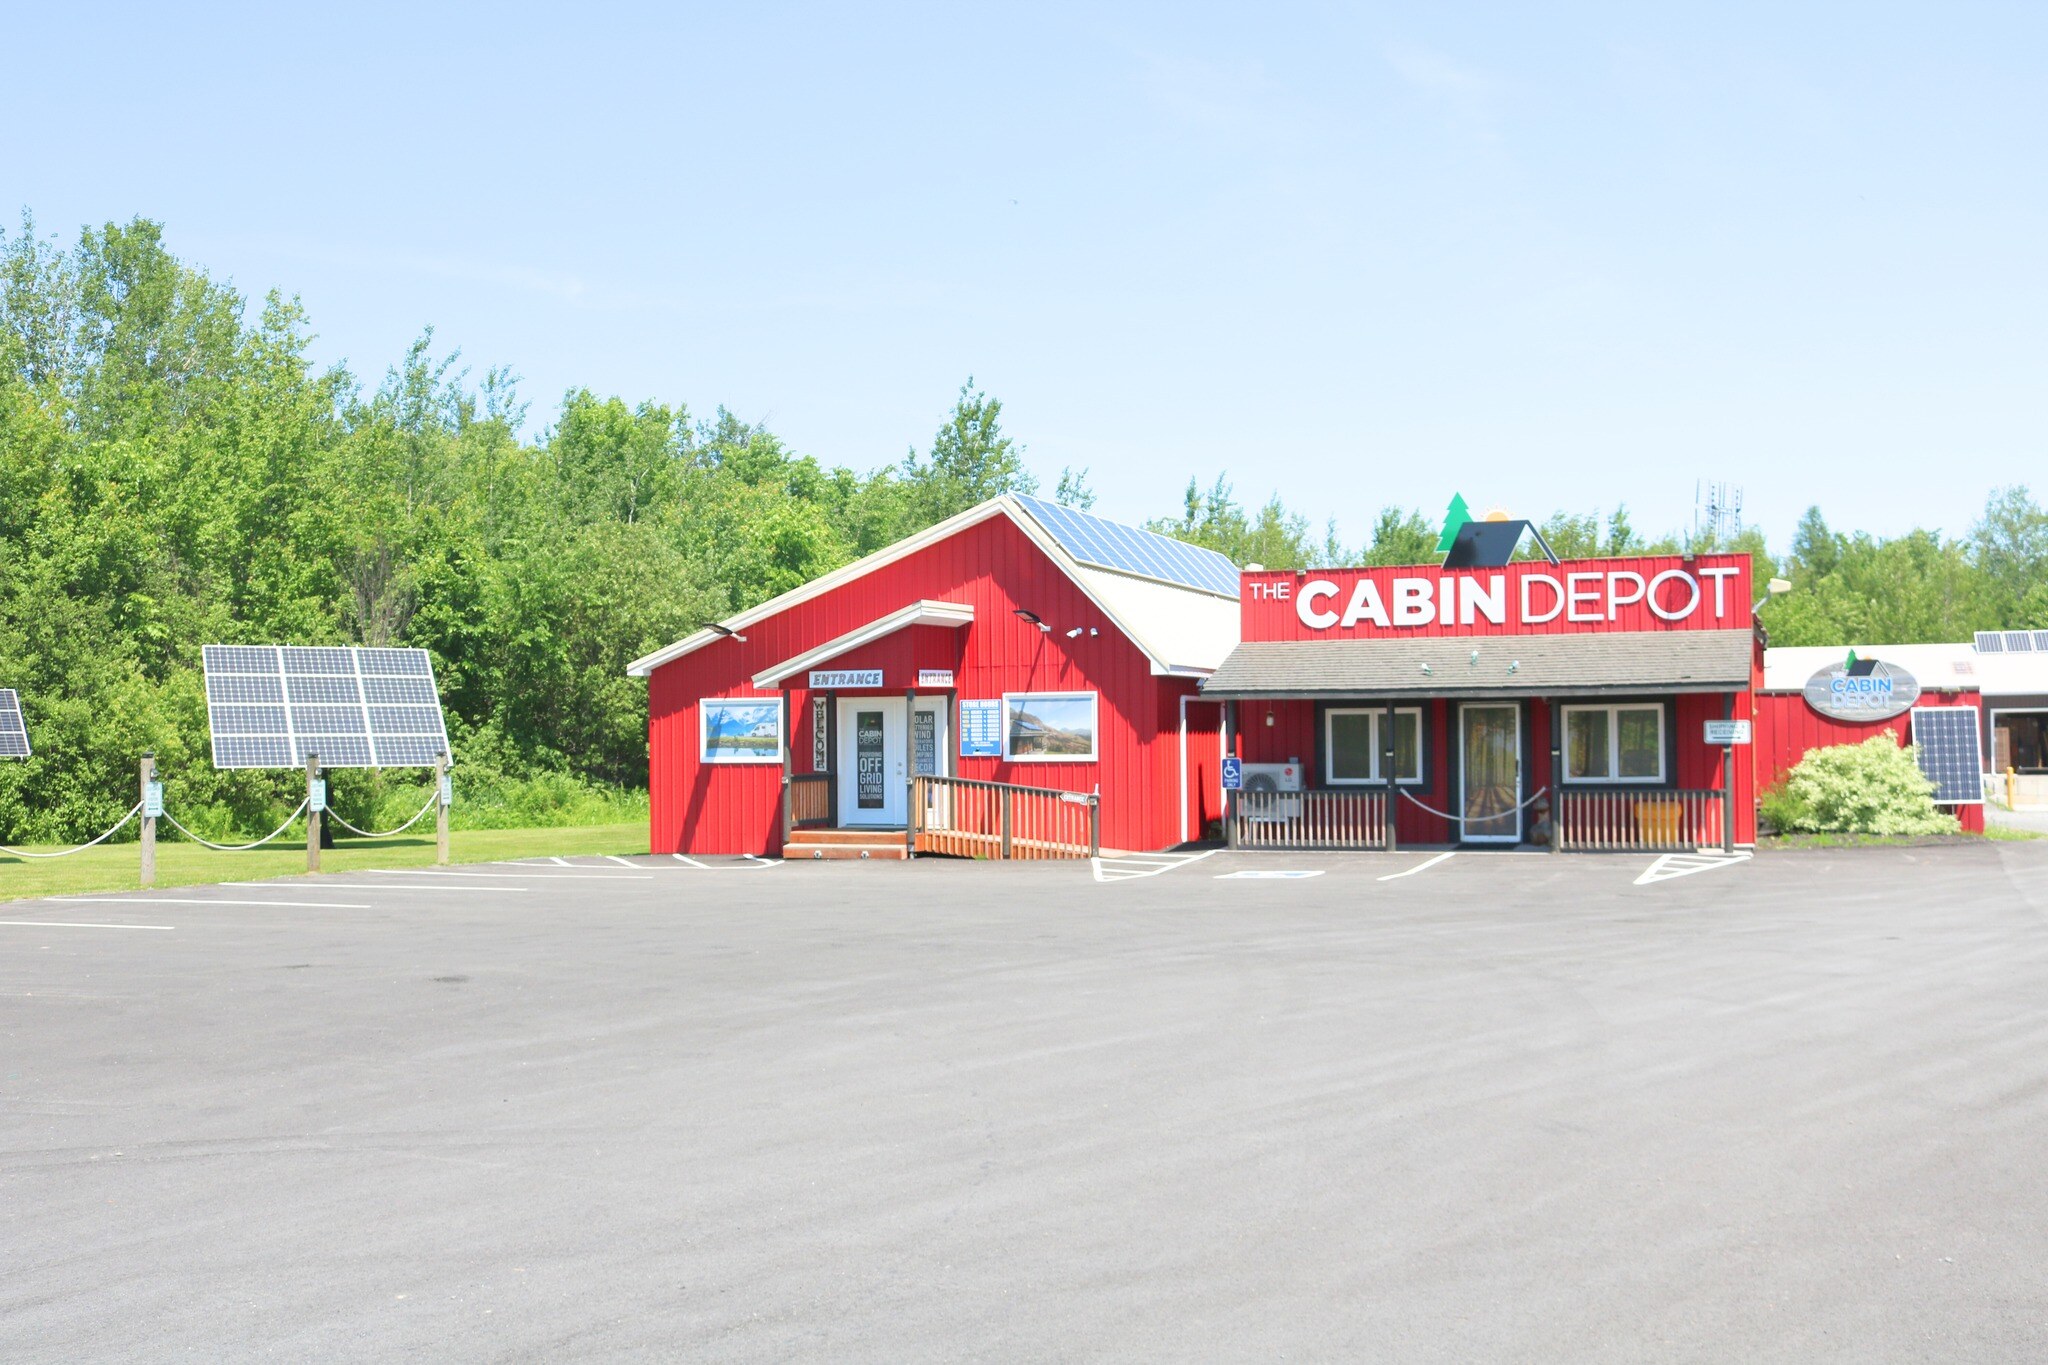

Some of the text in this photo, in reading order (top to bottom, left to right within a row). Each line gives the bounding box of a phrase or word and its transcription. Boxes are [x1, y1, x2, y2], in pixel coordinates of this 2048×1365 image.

[1249, 567, 1740, 629] THE CABIN DEPOT
[813, 673, 880, 686] ENTRANCE
[921, 673, 952, 684] ENTRANCE
[1831, 677, 1892, 693] CABIN
[1831, 692, 1892, 708] DEPOT
[915, 715, 933, 724] OLAR
[814, 701, 825, 769] WELCOME
[860, 758, 882, 773] OFF
[860, 773, 882, 785] GRID
[860, 785, 882, 794] LIVING
